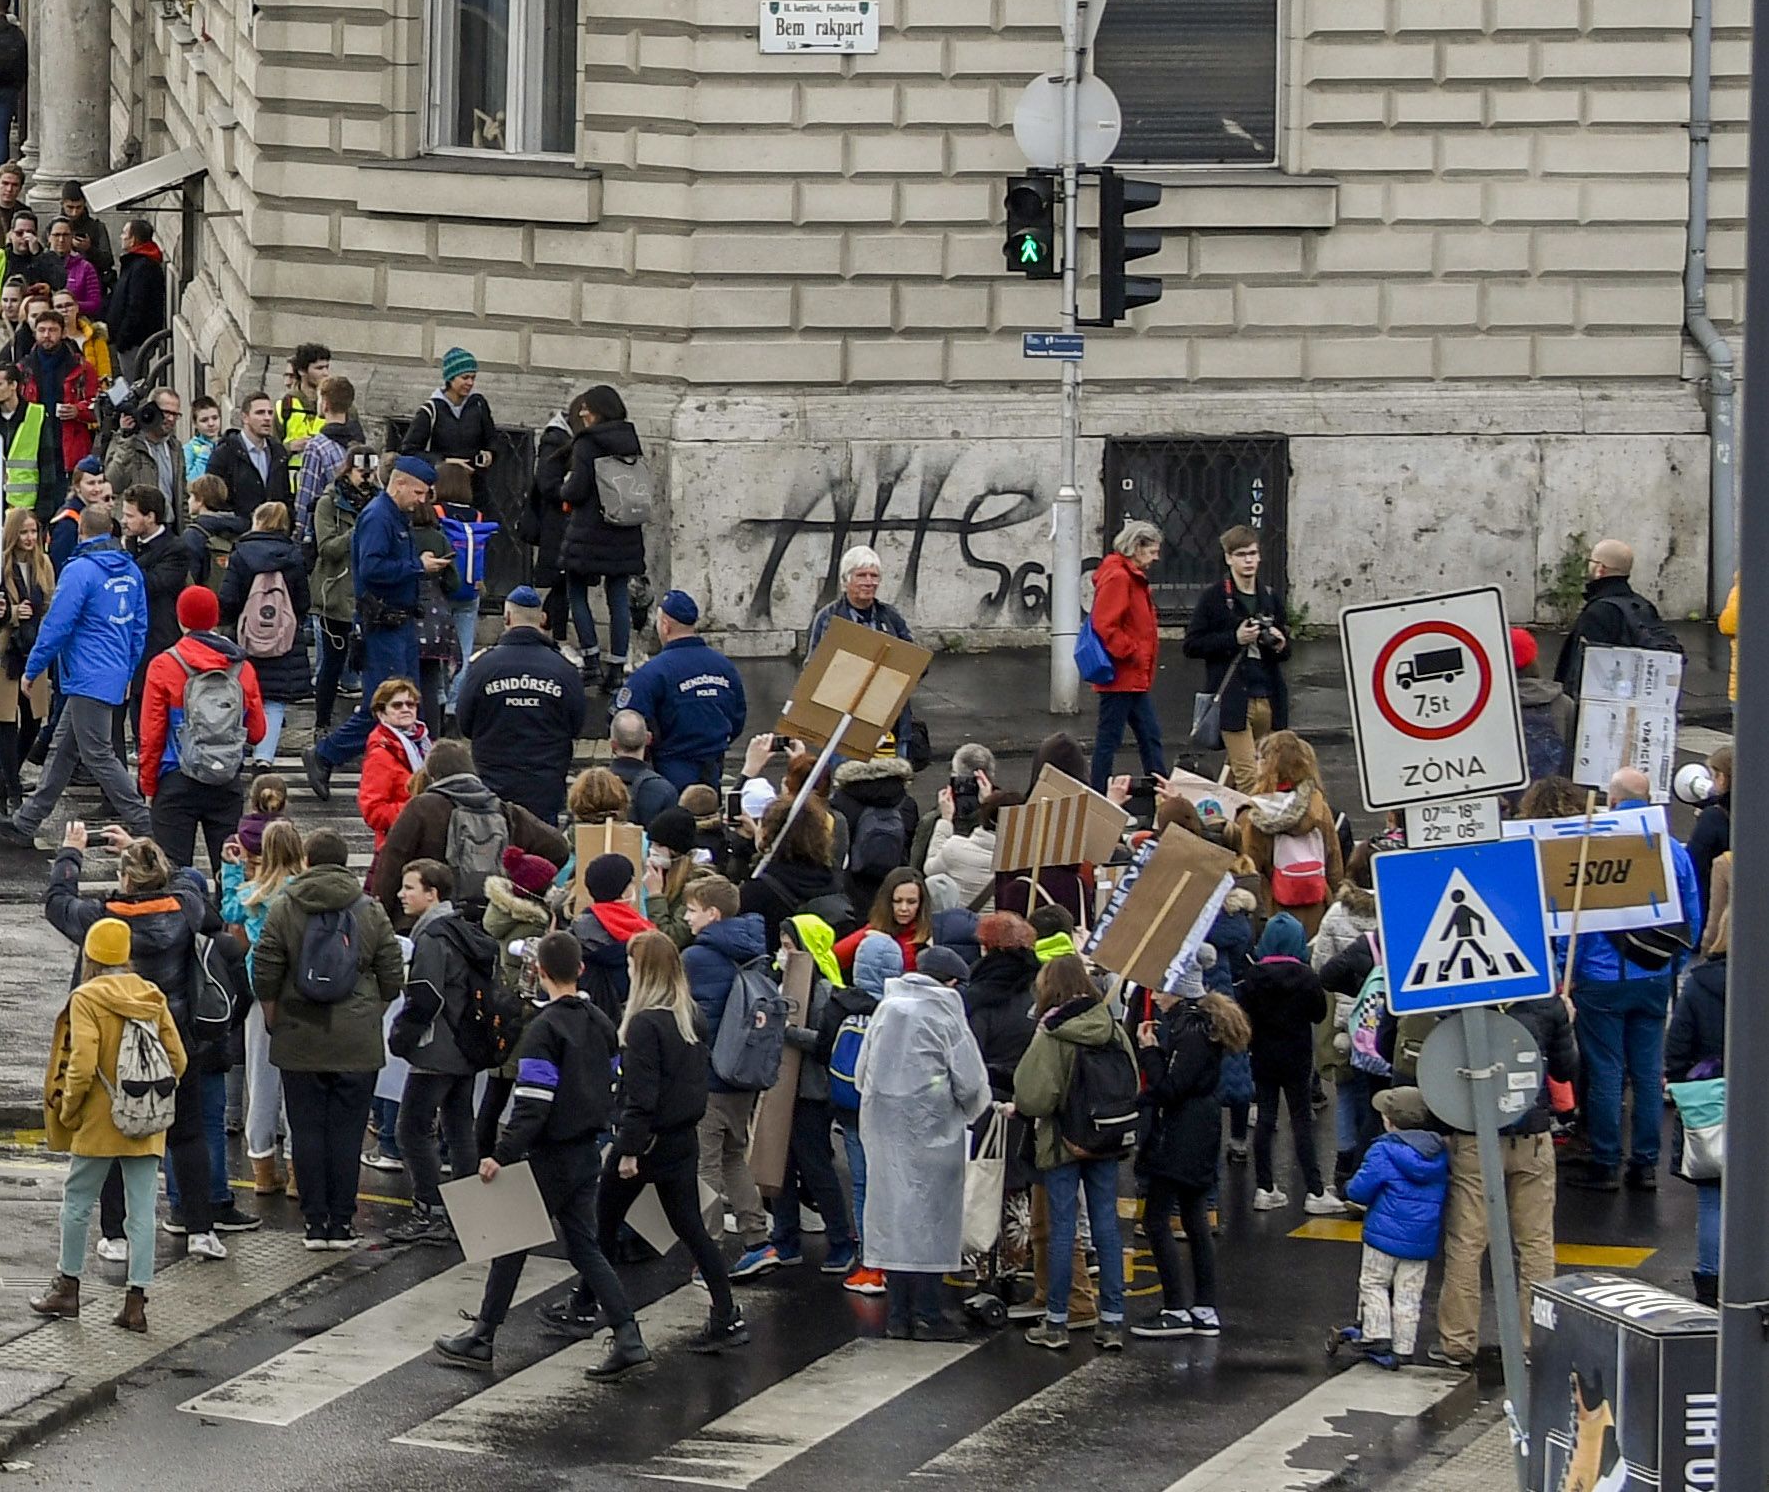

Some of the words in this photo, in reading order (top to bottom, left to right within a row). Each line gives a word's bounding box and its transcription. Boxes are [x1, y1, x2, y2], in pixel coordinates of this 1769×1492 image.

[775, 17, 805, 36] Bem
[815, 17, 864, 41] rakpart
[485, 673, 563, 698] RENDŐRSÉG
[679, 673, 730, 693] RENDŐRSÉG
[505, 697, 541, 707] POLICE
[1401, 754, 1487, 788] ZÓNA
